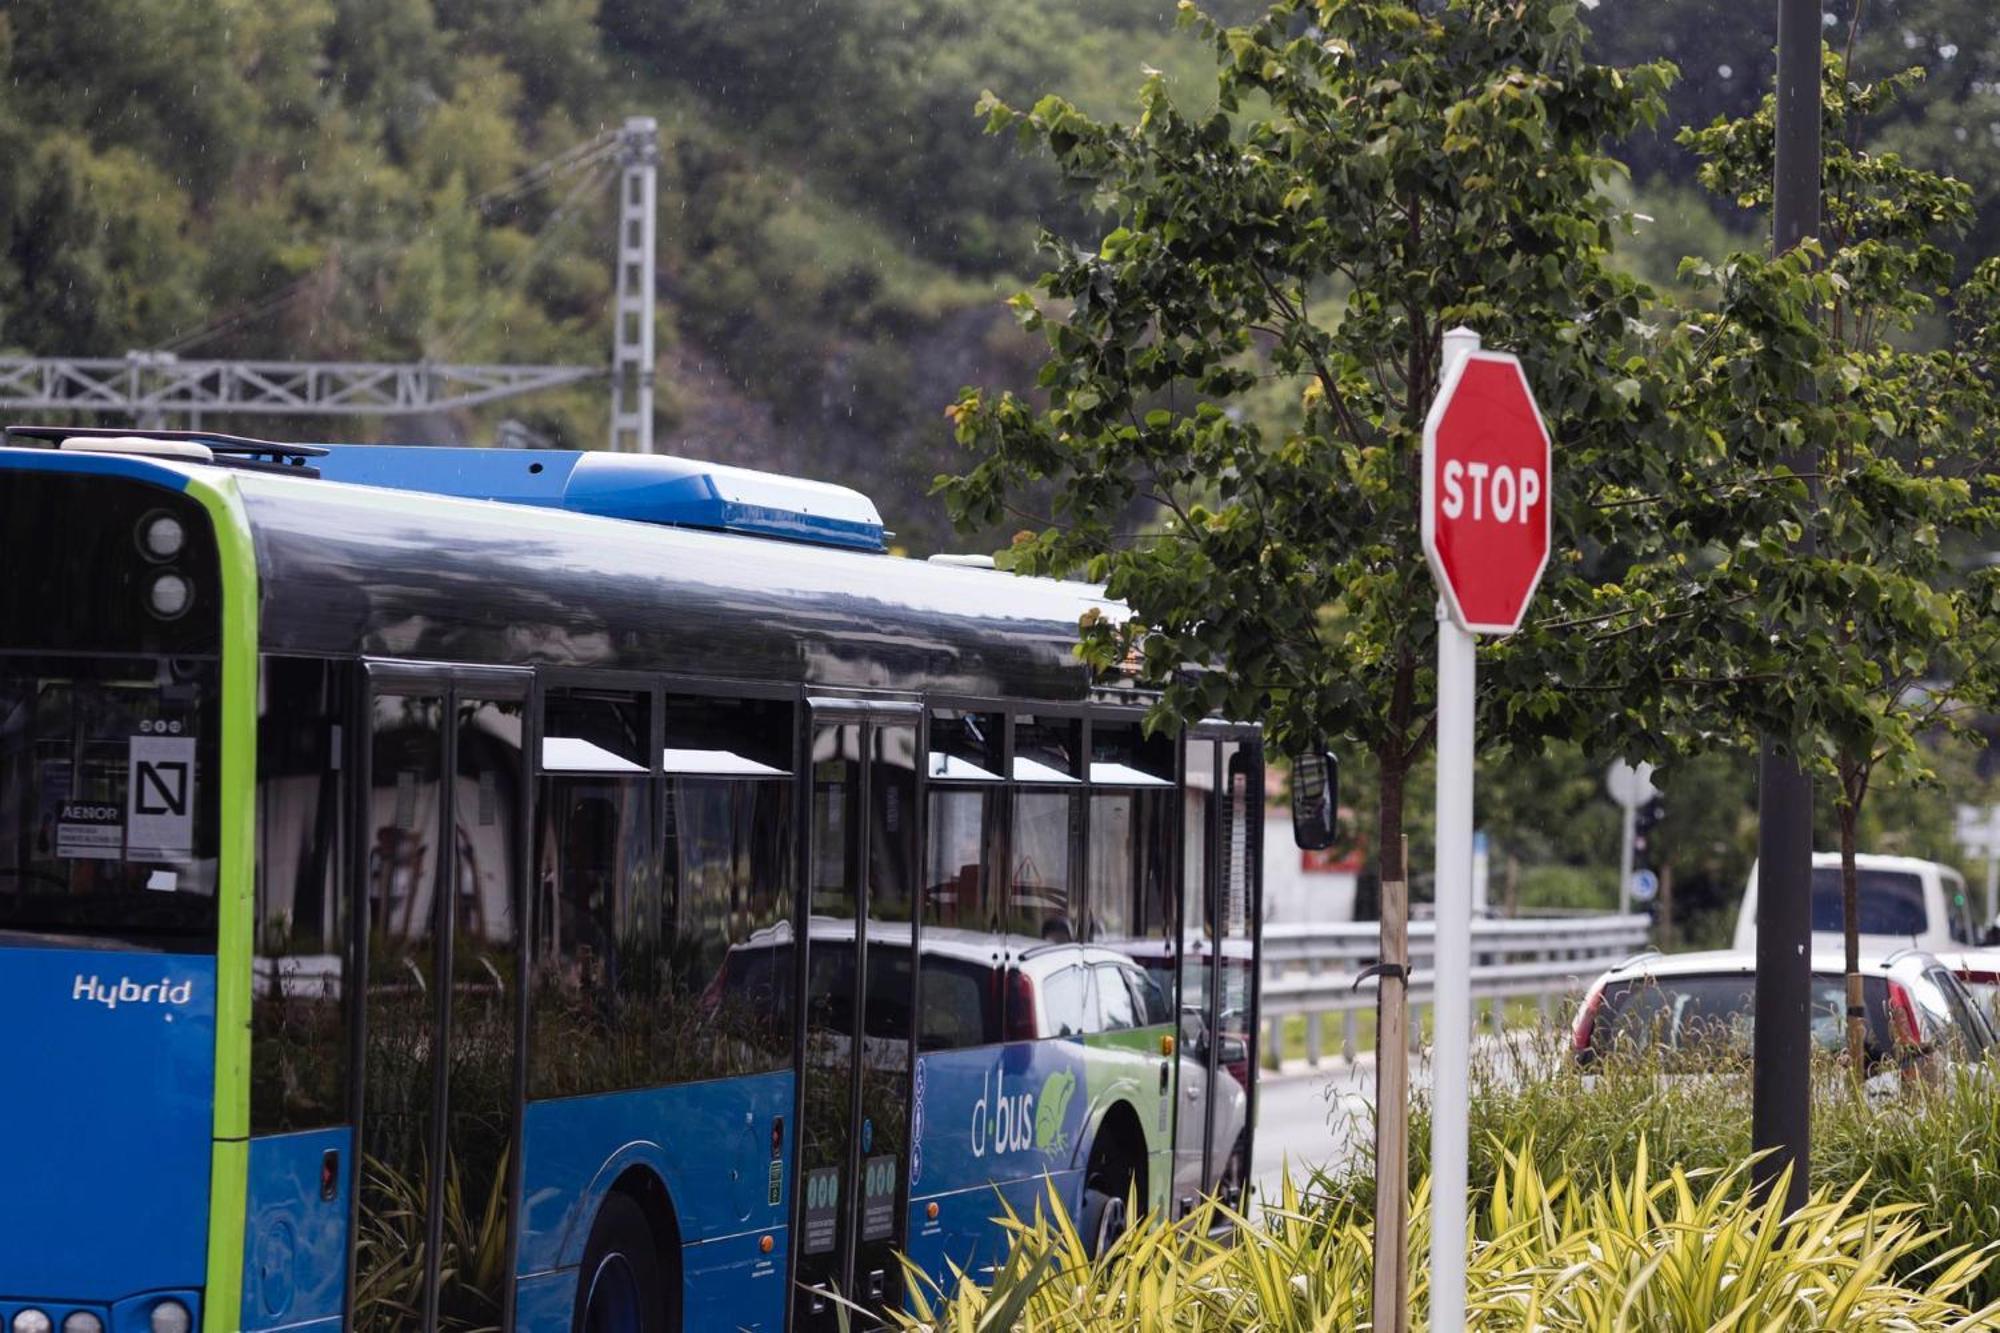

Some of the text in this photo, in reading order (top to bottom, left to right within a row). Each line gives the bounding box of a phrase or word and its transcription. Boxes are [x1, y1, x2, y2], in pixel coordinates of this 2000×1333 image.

[1441, 459, 1540, 524] STOP
[61, 805, 118, 820] AENOR
[72, 975, 192, 1008] Hybrid
